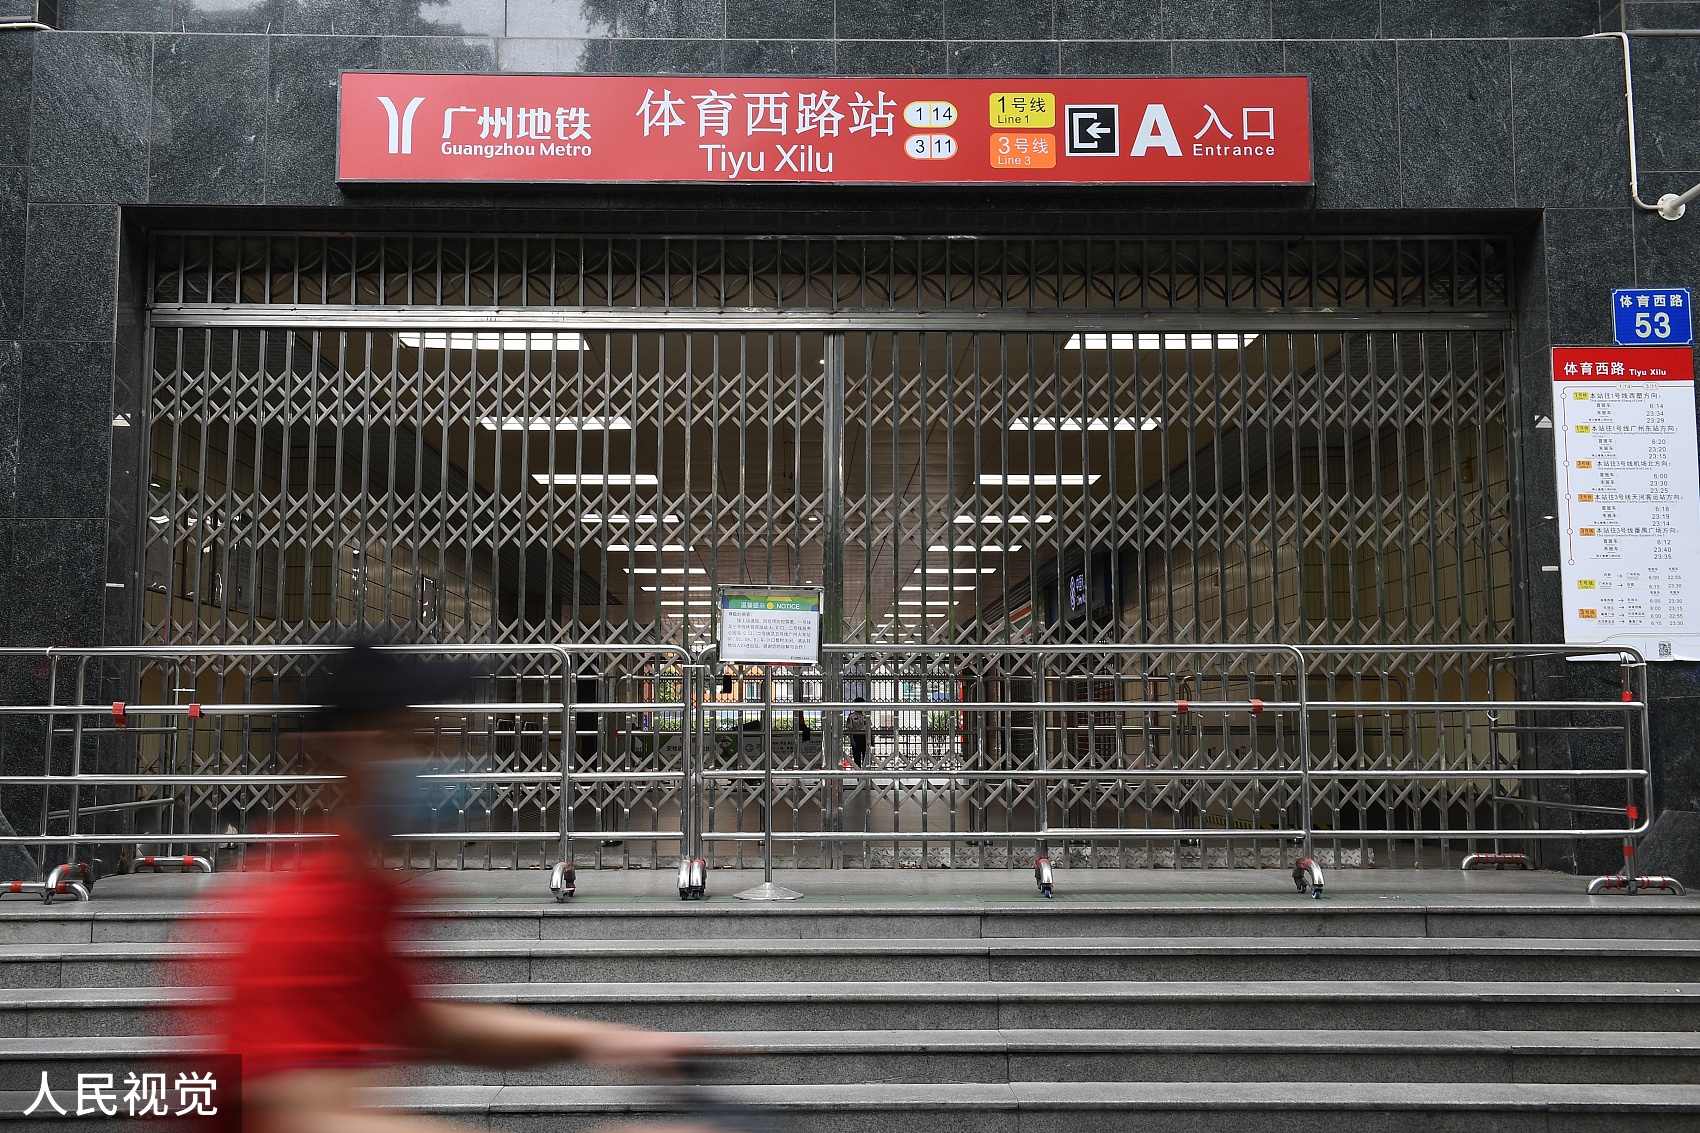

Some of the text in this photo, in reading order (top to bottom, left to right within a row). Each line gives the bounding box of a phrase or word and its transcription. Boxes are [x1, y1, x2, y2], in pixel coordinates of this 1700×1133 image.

[636, 88, 897, 138] 体育西路站
[997, 96, 1046, 114] 1号线
[916, 106, 952, 122] 1 14
[998, 114, 1029, 124] Line 1
[1193, 104, 1274, 140] 入口
[442, 106, 592, 141] 广州地铁
[1130, 104, 1183, 157] A
[441, 142, 592, 159] Guangzhou Metro
[915, 139, 952, 154] 3 11
[998, 136, 1048, 154] 3号线
[1193, 144, 1275, 156] Entrance
[698, 144, 834, 180] Tiyu Xilu
[998, 155, 1031, 166] Line 3
[1620, 294, 1683, 308] 体育西路
[1635, 312, 1671, 338] 53
[1564, 362, 1626, 376] 体育西路
[1629, 368, 1647, 377] Tiyu
